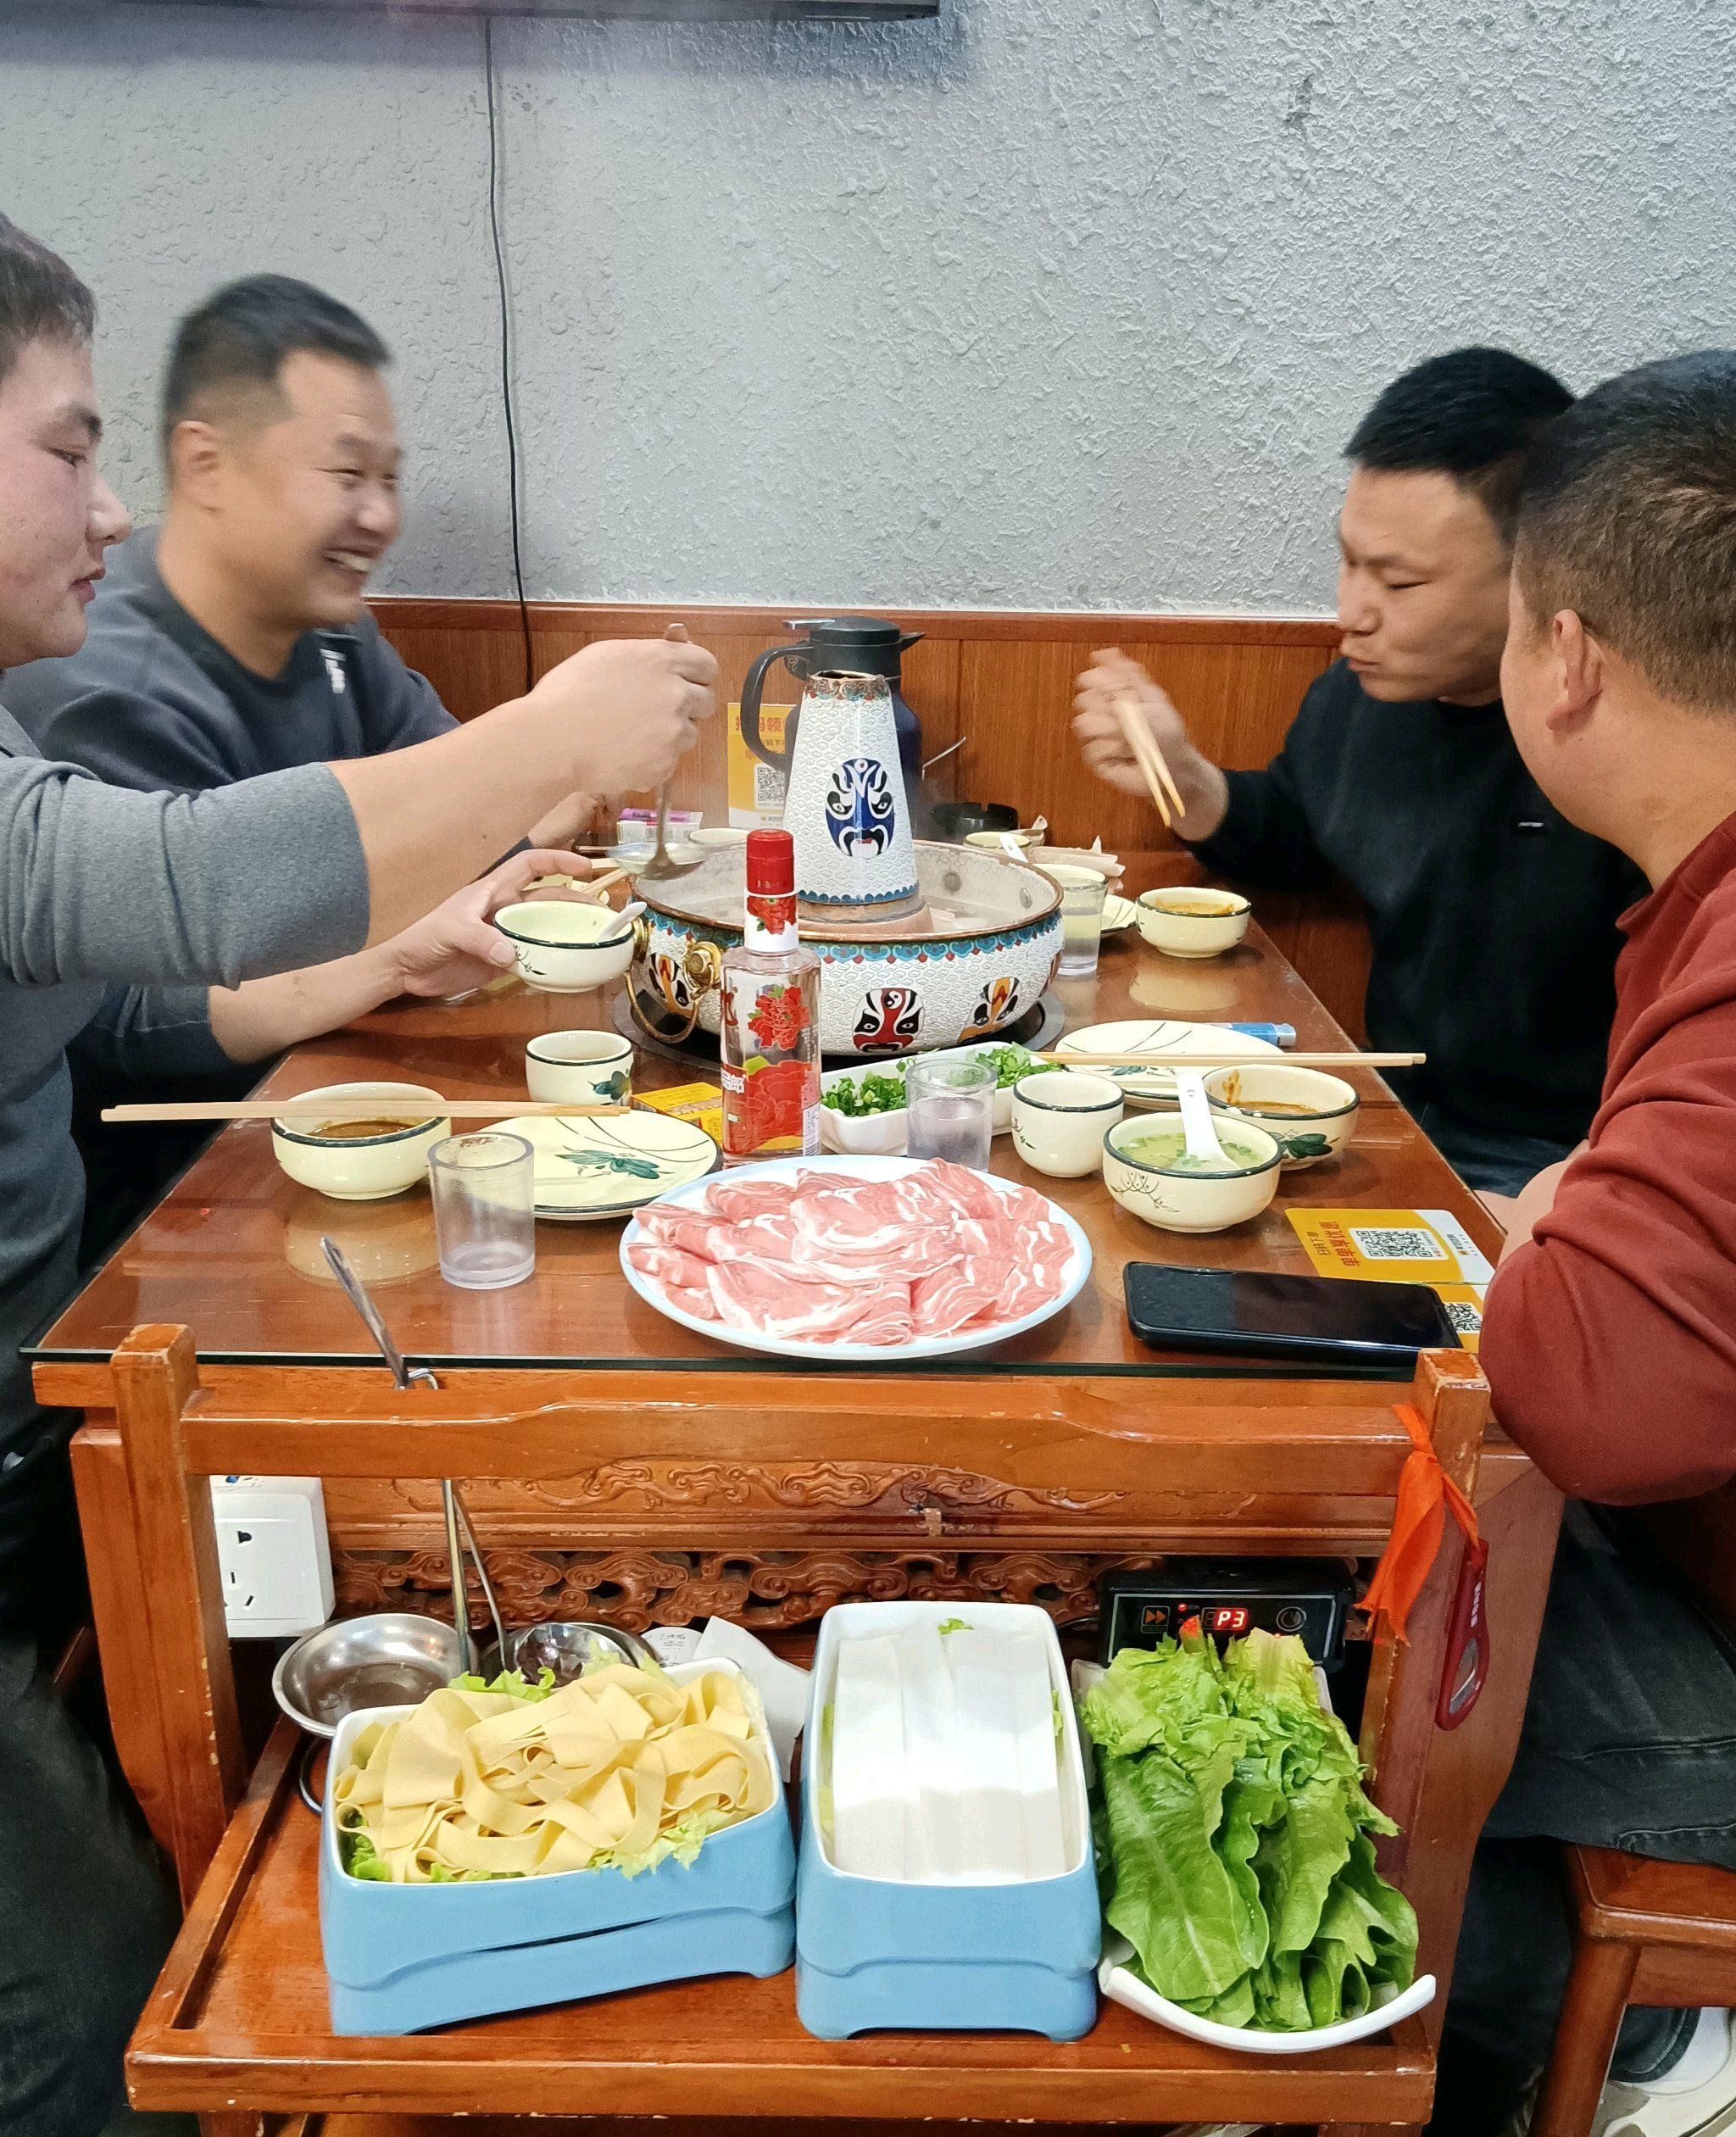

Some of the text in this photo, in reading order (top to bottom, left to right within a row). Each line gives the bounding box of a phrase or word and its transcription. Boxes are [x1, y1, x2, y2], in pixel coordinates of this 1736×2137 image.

[1319, 1221, 1361, 1266] 单单享优惠
[1217, 1611, 1245, 1628] P3
